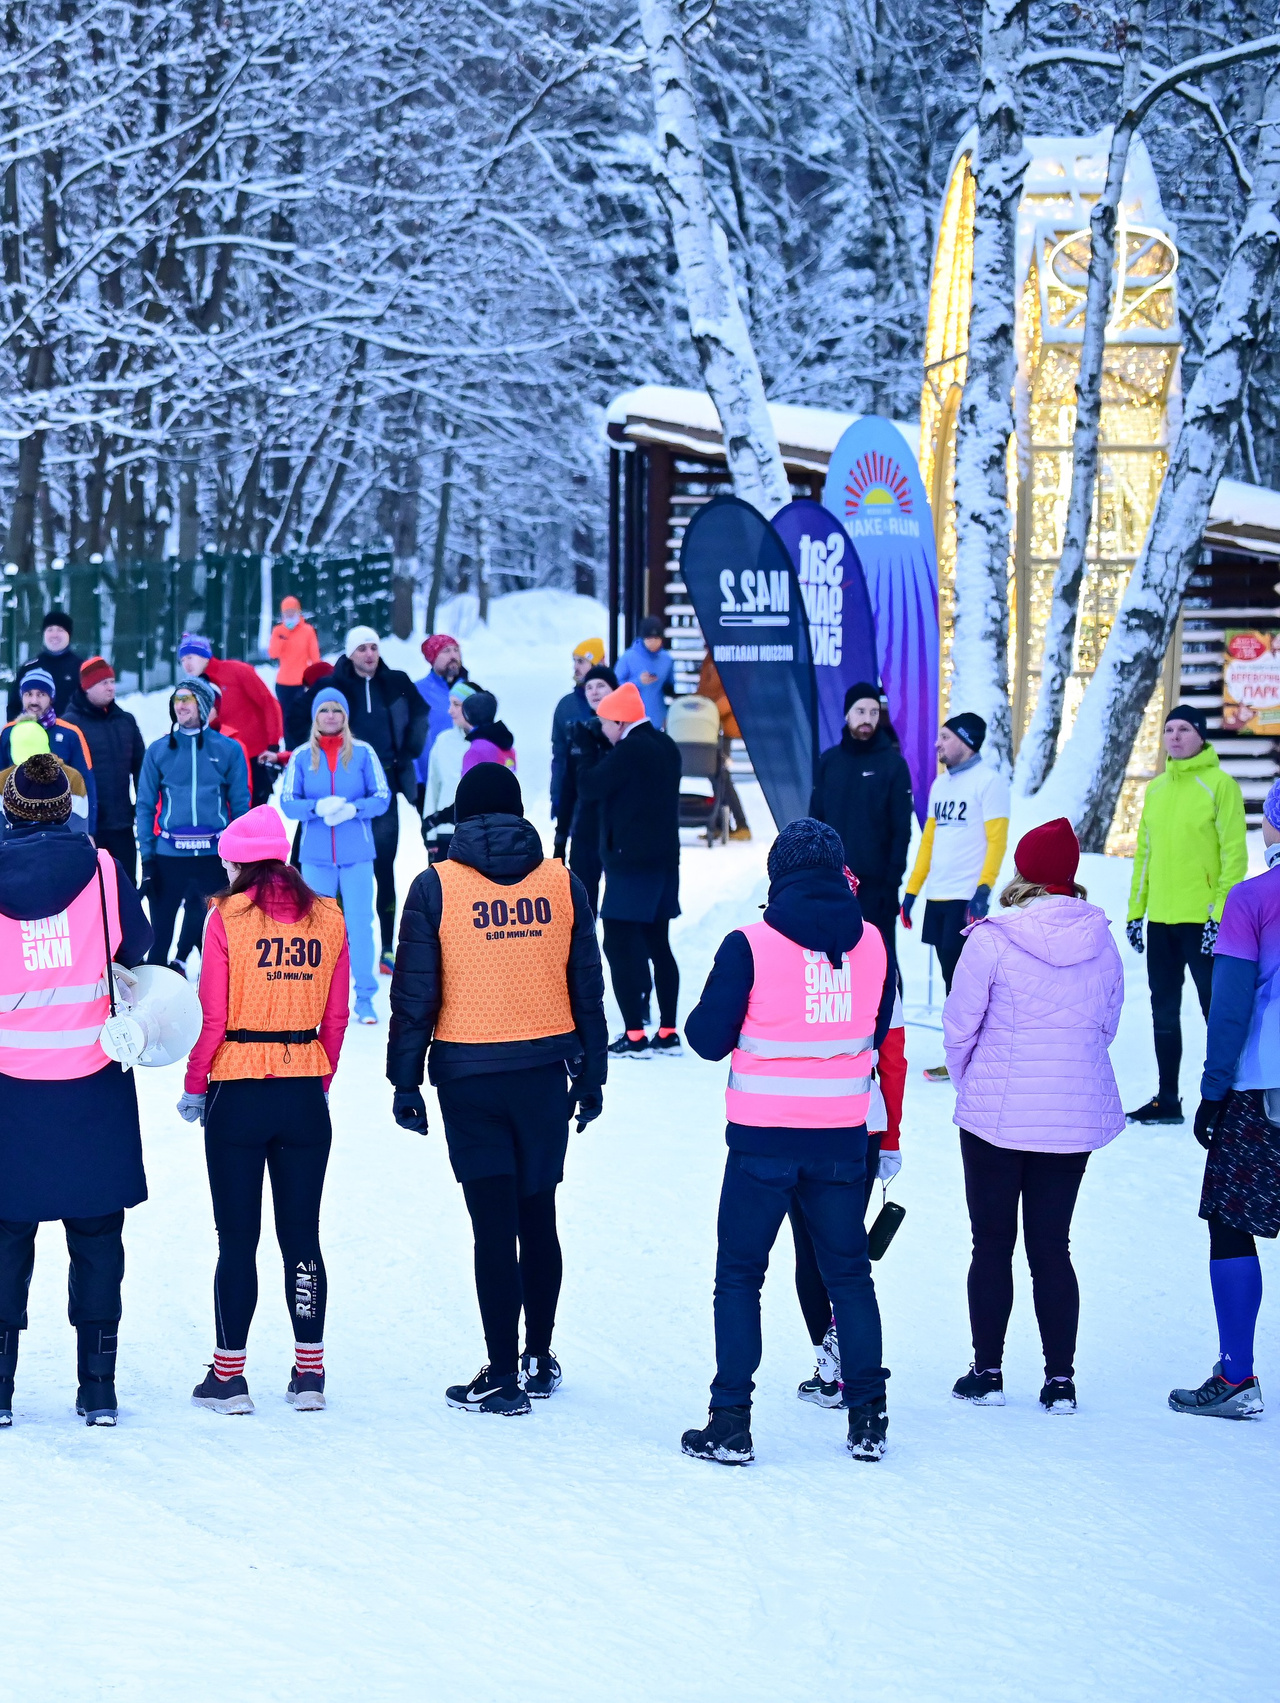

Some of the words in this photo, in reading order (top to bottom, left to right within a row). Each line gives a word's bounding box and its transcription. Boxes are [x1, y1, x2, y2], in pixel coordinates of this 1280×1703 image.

[889, 517, 920, 538] RUN
[175, 840, 211, 849] СУББОТА
[472, 897, 552, 929] 30:00
[486, 930, 505, 940] 6:00
[22, 938, 72, 972] 5KM
[256, 937, 322, 968] 27:30
[804, 962, 852, 994] 9AM
[805, 992, 852, 1024] 5KM
[295, 1272, 313, 1319] RUN
